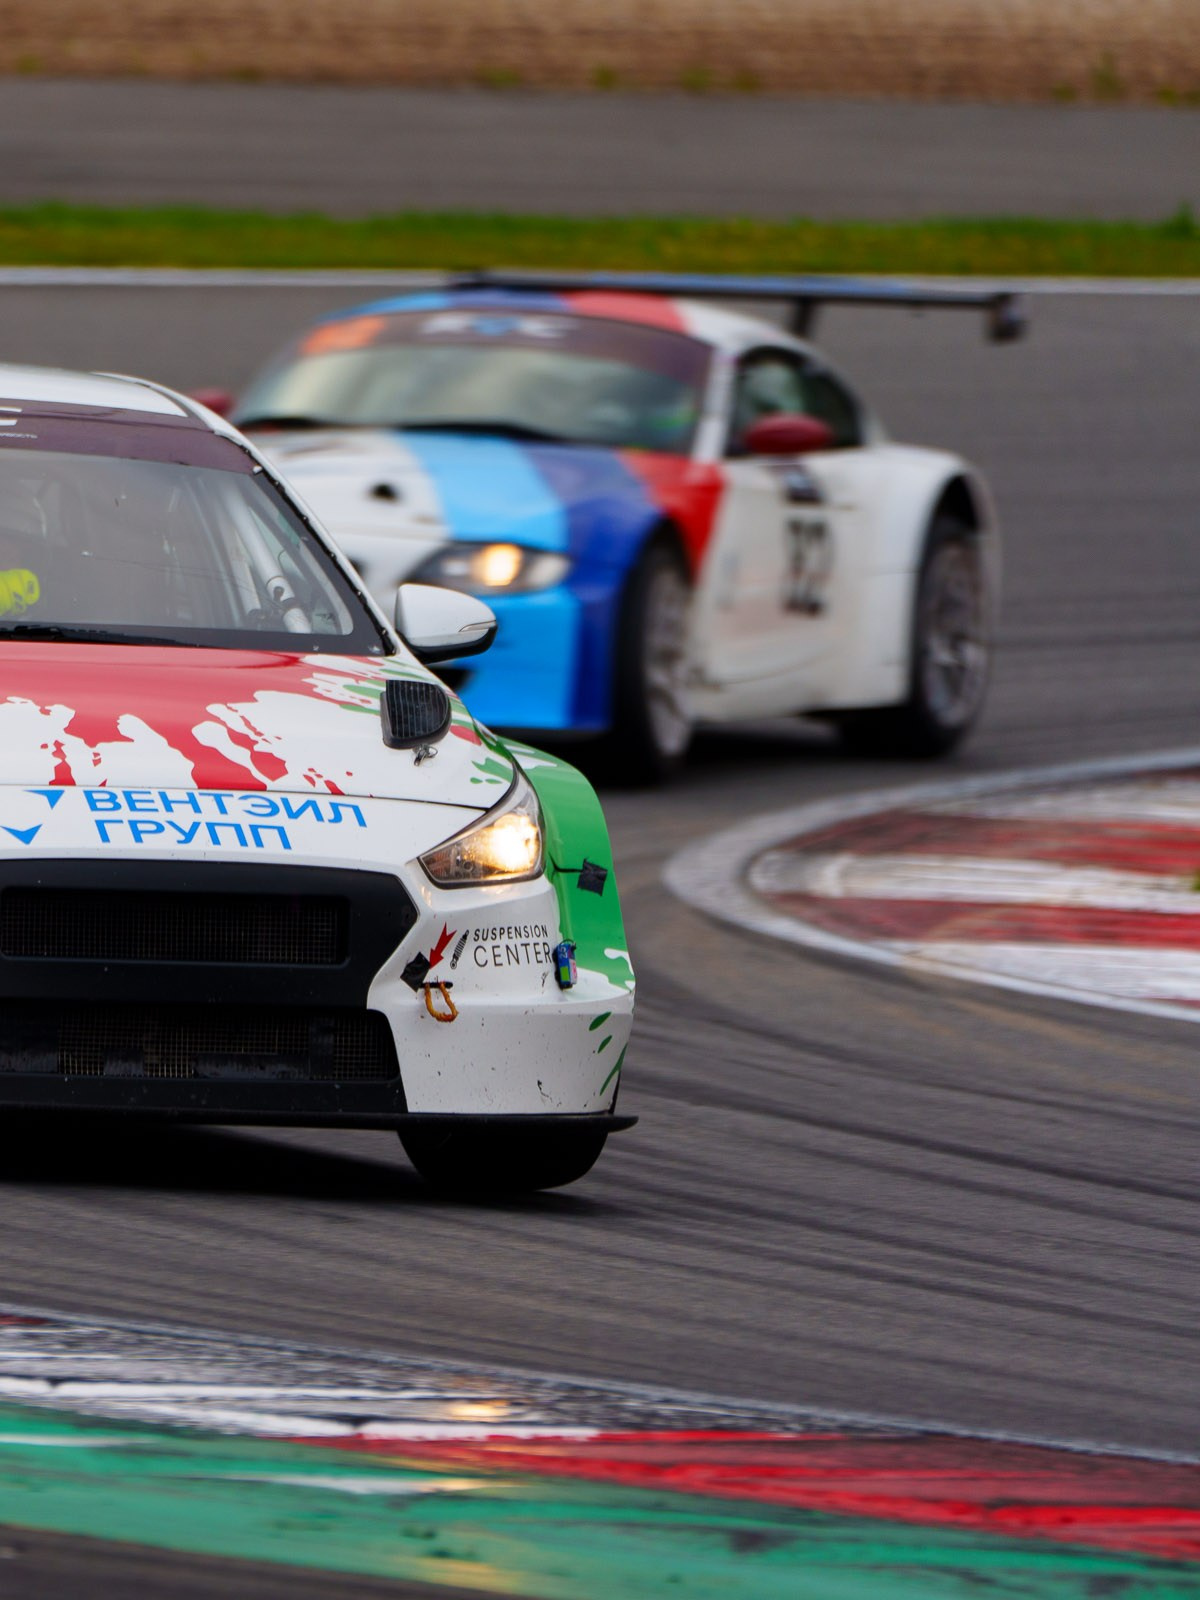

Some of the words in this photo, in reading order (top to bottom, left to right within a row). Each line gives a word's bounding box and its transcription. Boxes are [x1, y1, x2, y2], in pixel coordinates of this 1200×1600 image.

[83, 789, 368, 828] ВЕНТЭИЛ
[94, 819, 293, 850] ГРУПП
[473, 924, 548, 942] SUSPENSION
[473, 943, 555, 968] CENTER
